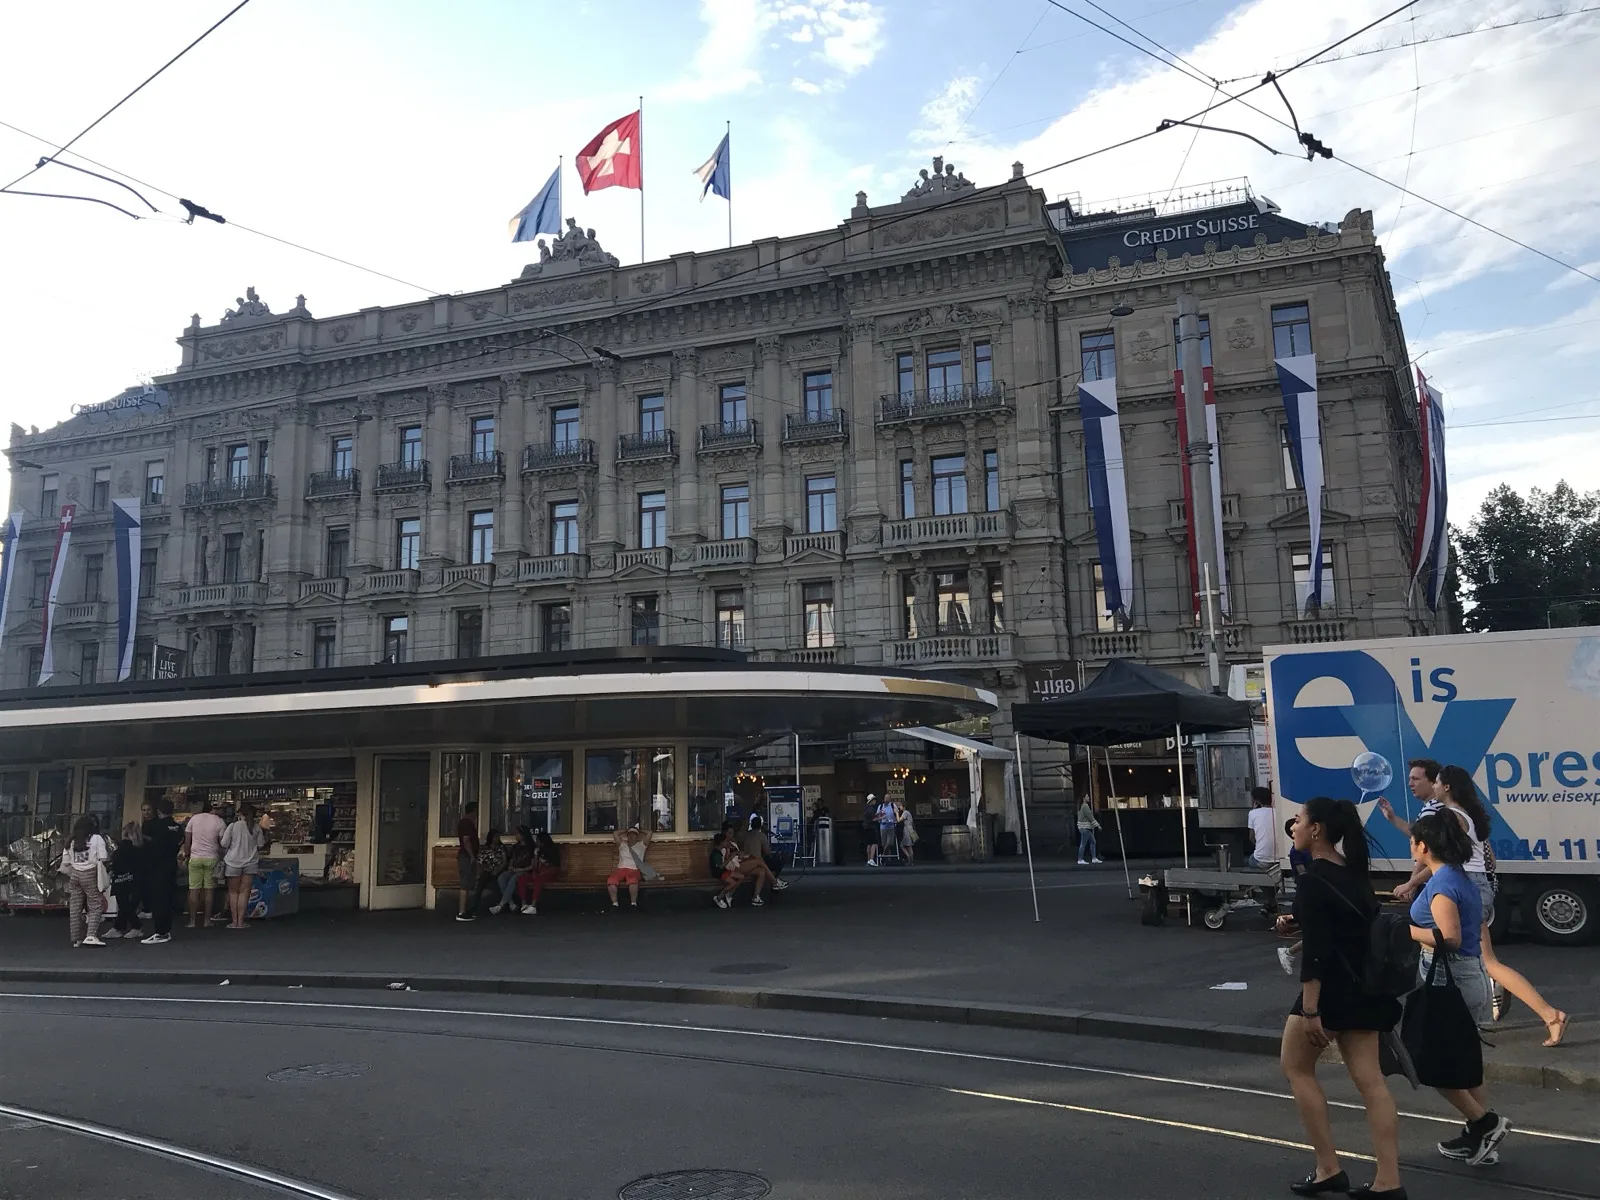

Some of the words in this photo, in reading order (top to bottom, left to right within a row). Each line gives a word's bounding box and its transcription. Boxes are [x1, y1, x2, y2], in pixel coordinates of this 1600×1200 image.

[1123, 224, 1193, 248] CREDIT
[1196, 214, 1259, 237] SUISSE
[109, 395, 143, 409] SUISSE
[160, 660, 176, 672] LIVE
[233, 765, 276, 780] kiosk
[1559, 838, 1587, 860] 11
